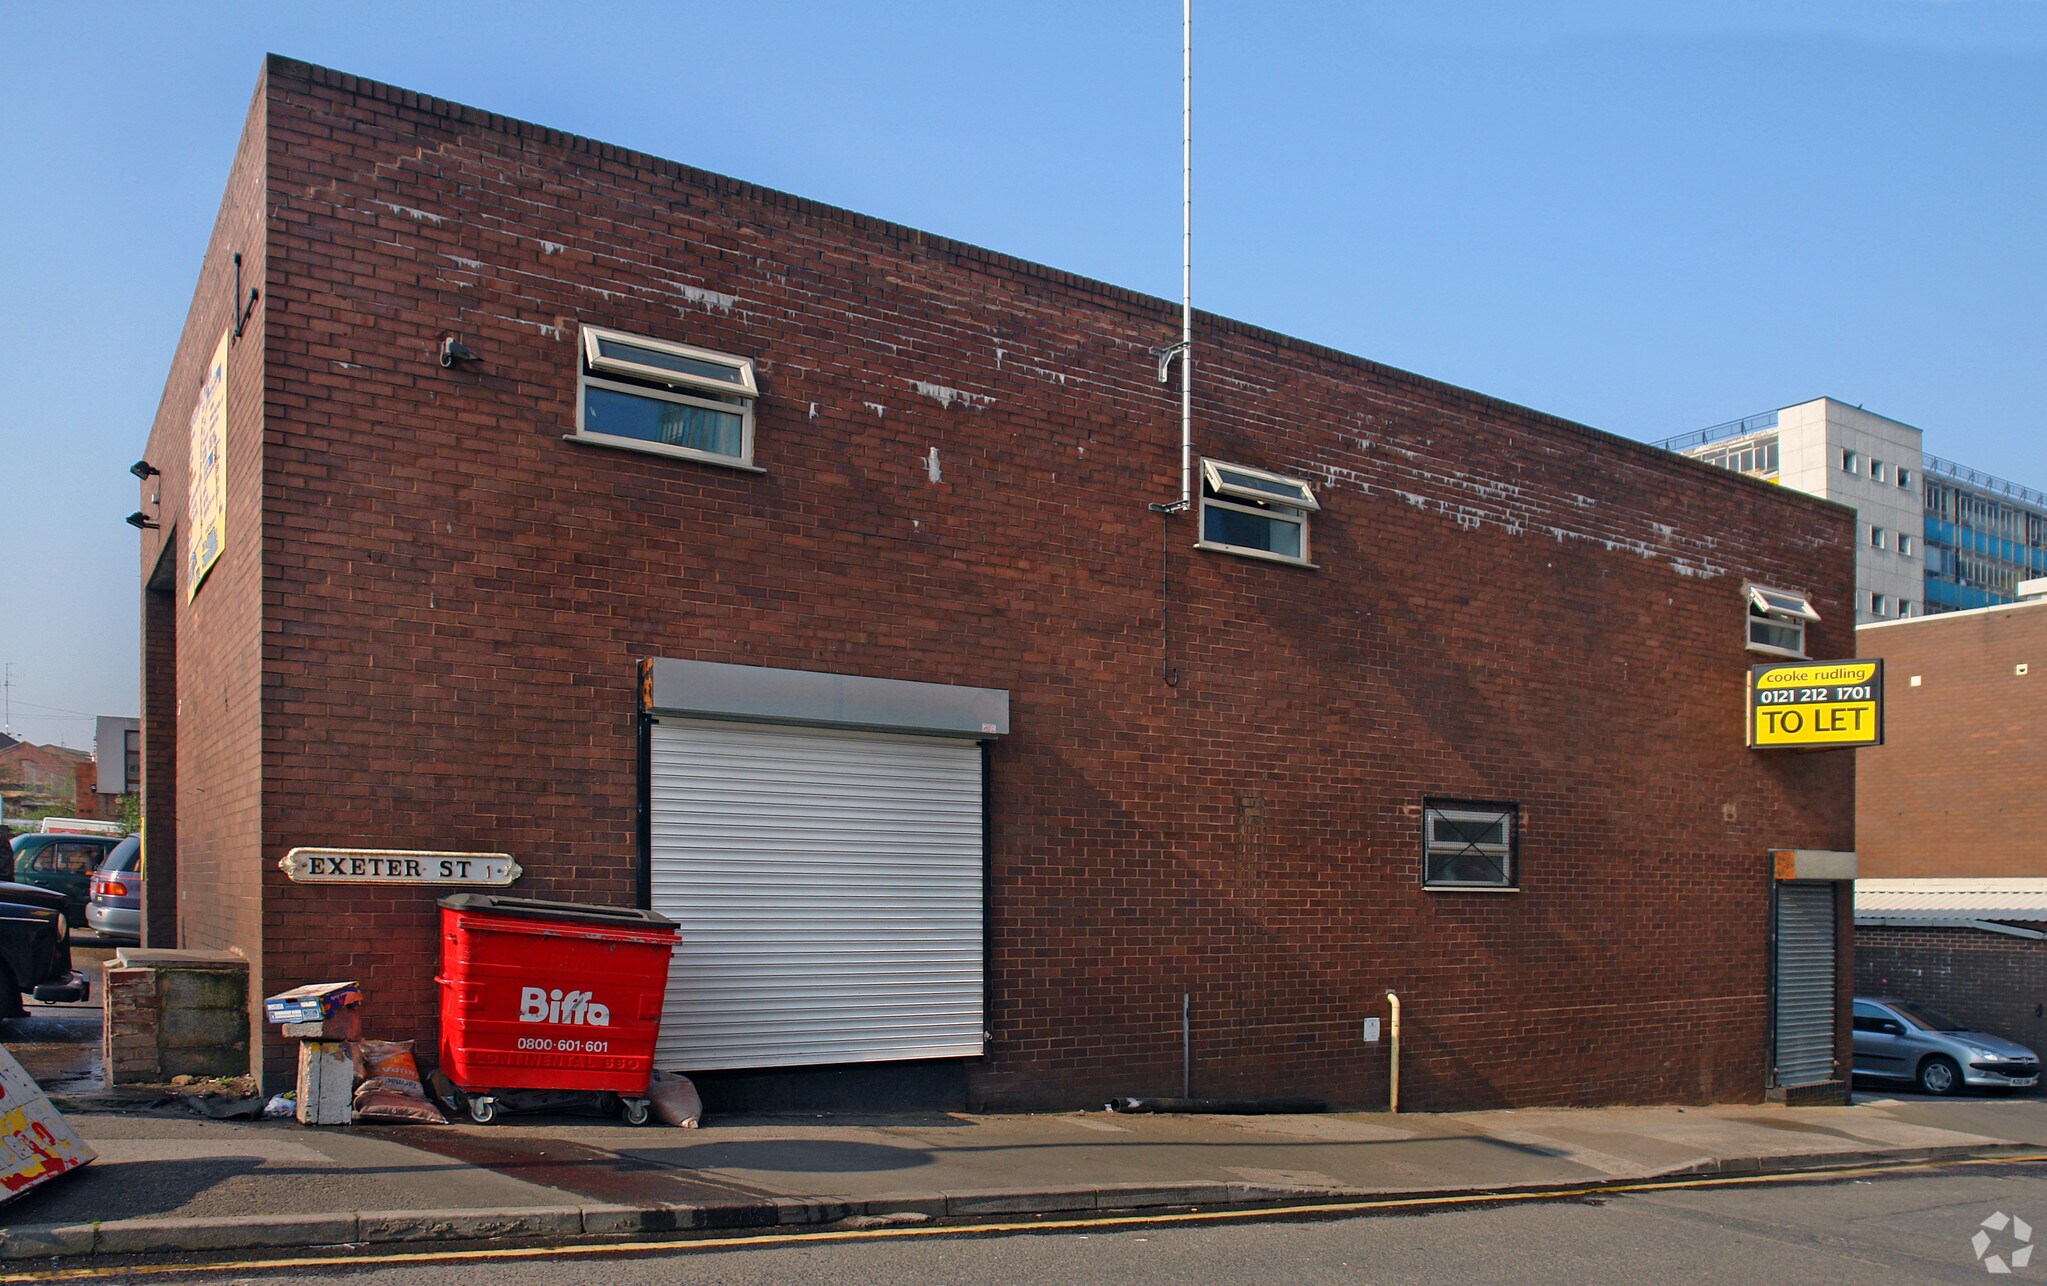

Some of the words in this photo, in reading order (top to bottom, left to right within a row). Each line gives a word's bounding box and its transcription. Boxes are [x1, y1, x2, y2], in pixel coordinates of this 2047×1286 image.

[1767, 671, 1808, 682] cooke
[1815, 668, 1865, 680] rudling
[1761, 689, 1794, 703] 0121
[1800, 688, 1827, 701] 212
[1837, 686, 1870, 700] 1701
[1762, 710, 1803, 734] TO
[1815, 707, 1869, 732] LET
[309, 857, 421, 877] EXETER
[439, 860, 471, 878] ST
[519, 986, 610, 1026] Biffa
[475, 1053, 595, 1068] CONTINENTAL
